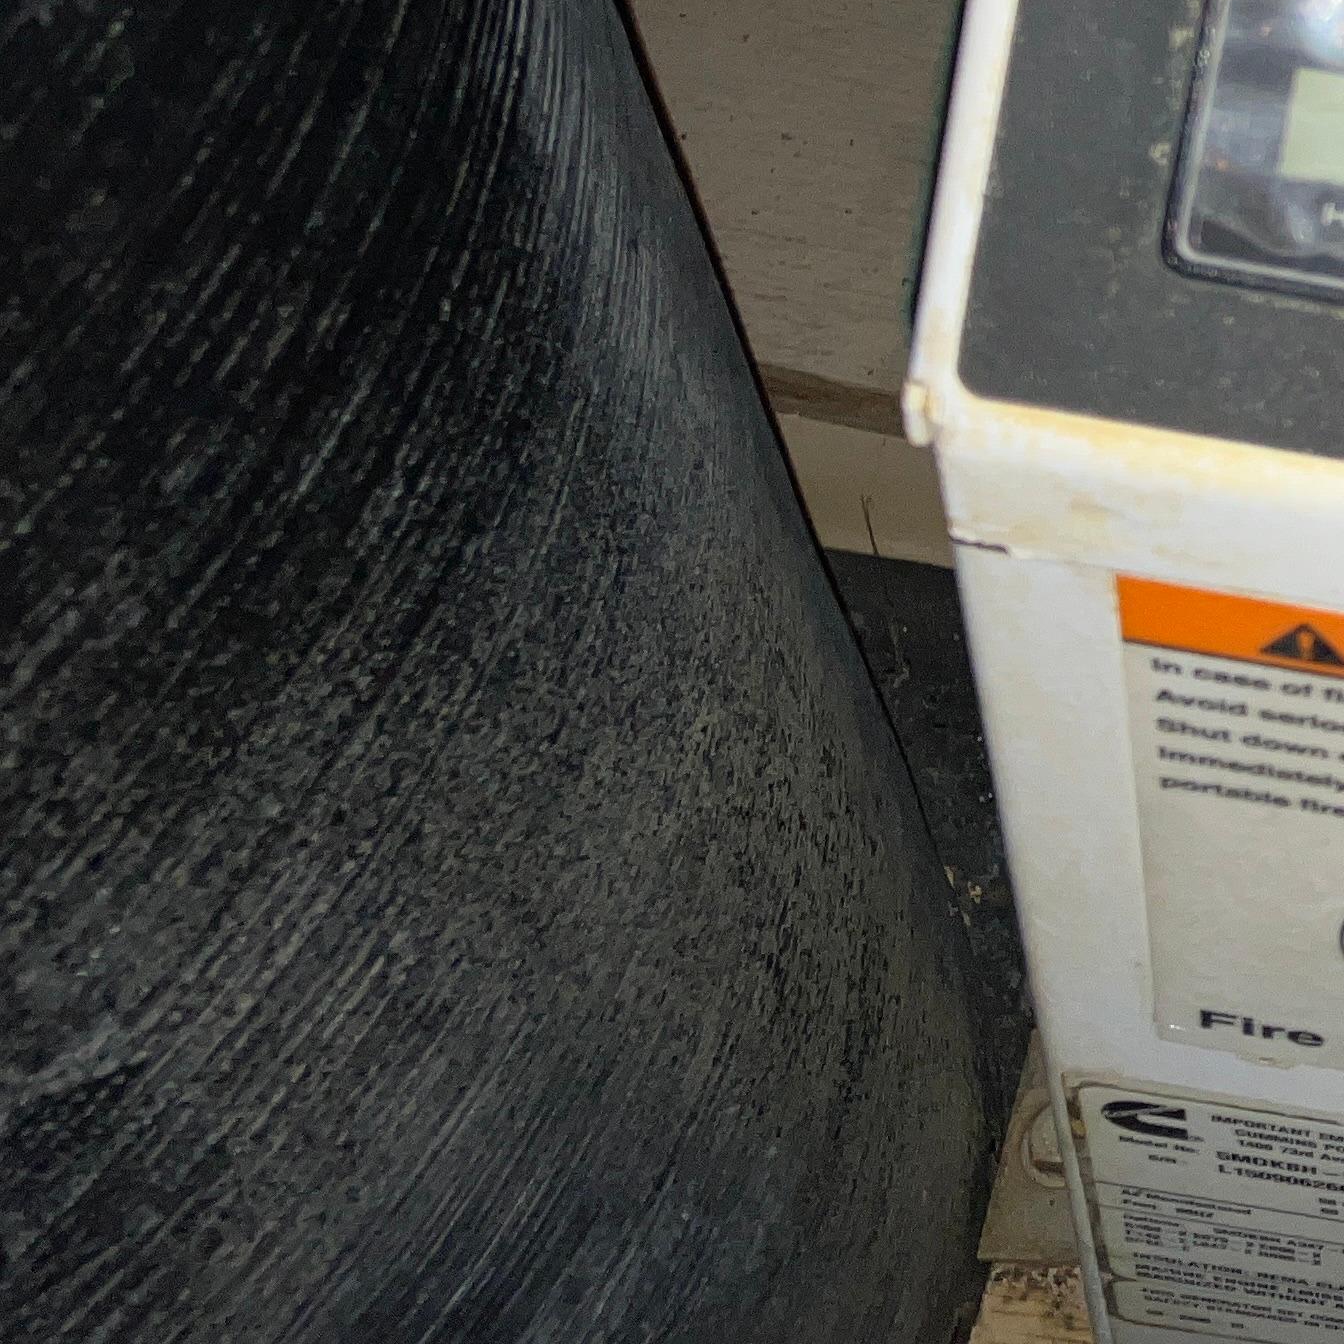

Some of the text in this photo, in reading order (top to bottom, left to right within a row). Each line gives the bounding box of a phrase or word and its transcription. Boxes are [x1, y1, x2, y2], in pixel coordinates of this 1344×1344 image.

[1151, 657, 1181, 676] In
[1193, 667, 1269, 692] case
[1281, 680, 1312, 698] of
[1156, 687, 1249, 717] Avoid
[1155, 717, 1231, 743] Shut
[1240, 732, 1329, 759] down
[1159, 775, 1291, 808] portable
[1200, 1008, 1325, 1052] Fire
[1211, 1114, 1310, 1137] IMPORTANT
[1235, 1128, 1317, 1148] CUMMINS
